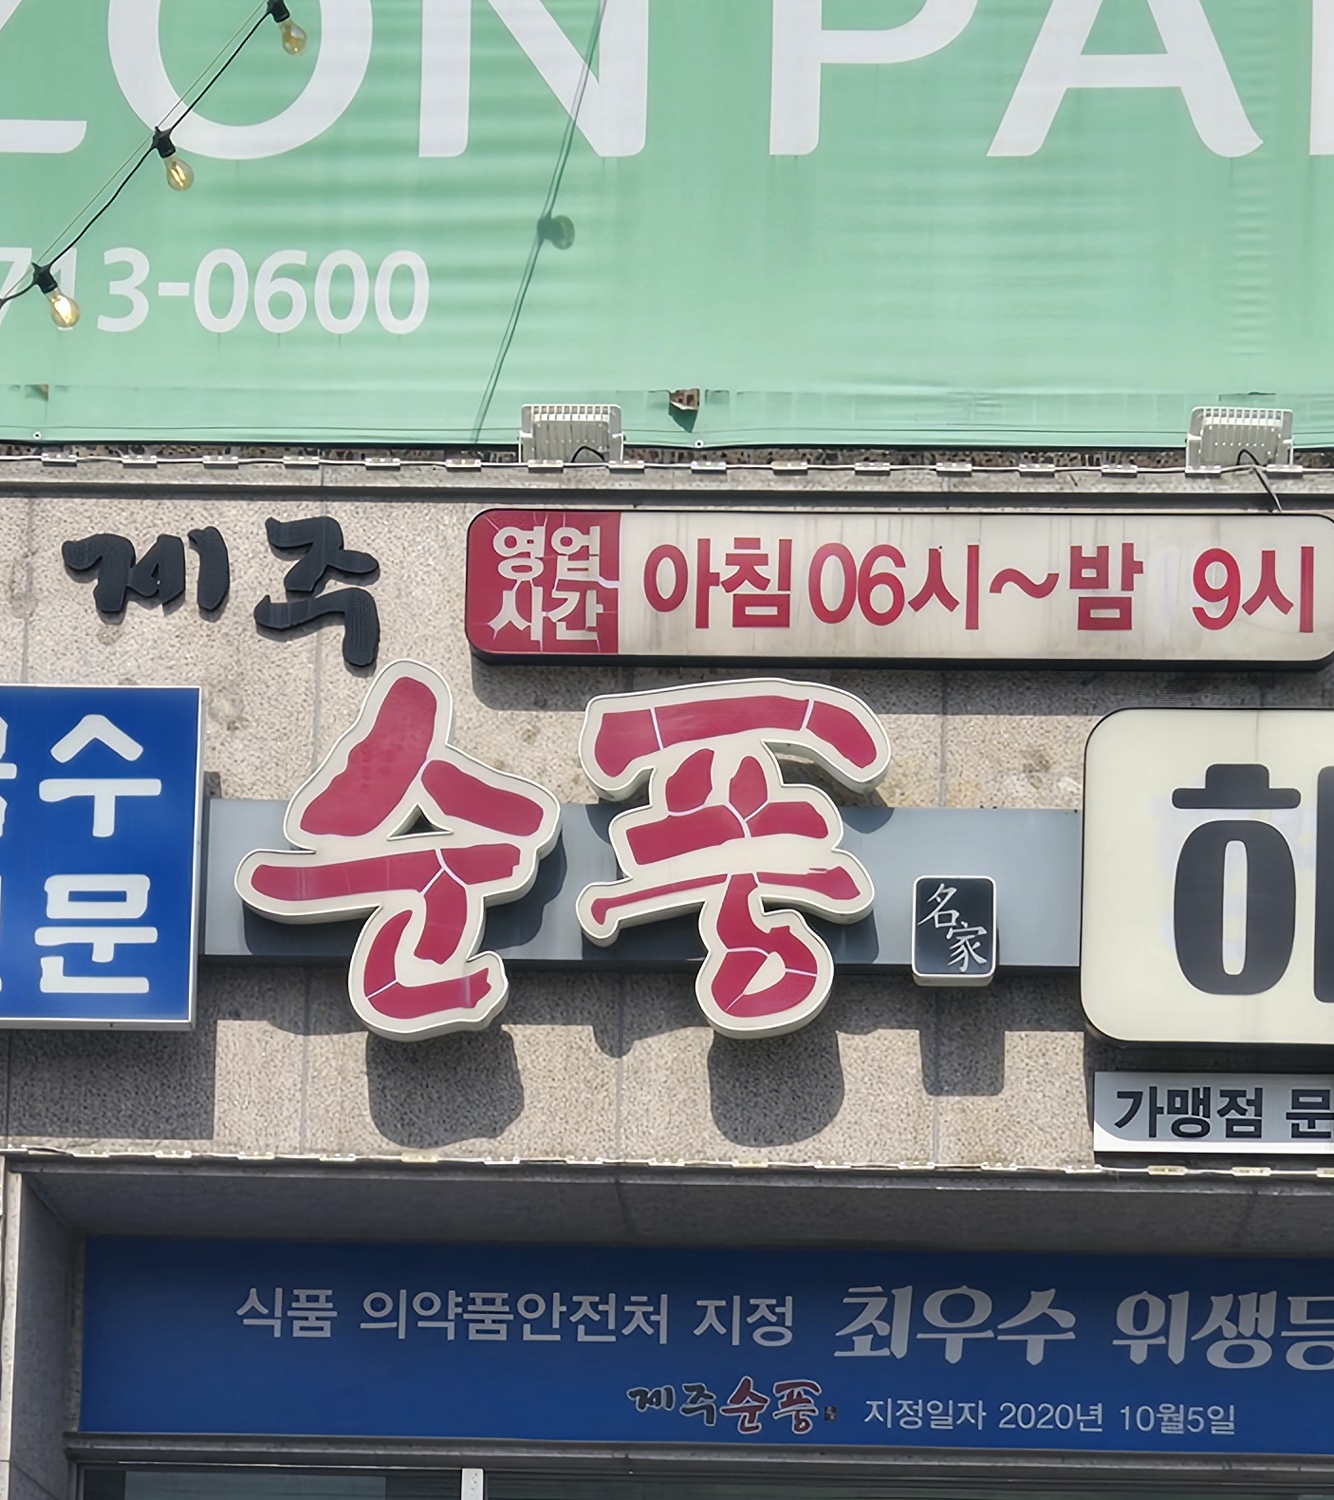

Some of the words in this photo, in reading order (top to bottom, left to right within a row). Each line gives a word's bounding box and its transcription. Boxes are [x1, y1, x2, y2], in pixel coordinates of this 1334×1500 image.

[62, 515, 381, 668] 제주
[492, 524, 603, 583] 영업
[1191, 544, 1316, 635] 9시
[489, 587, 605, 644] 시간
[245, 670, 883, 1024] 순풍
[915, 884, 989, 973] 名家
[1113, 1085, 1266, 1143] 가맹점
[235, 1286, 339, 1340] 식품
[358, 1287, 670, 1346] 의약품안전처
[691, 1293, 795, 1348] 지정
[832, 1284, 1078, 1366] 최우수
[861, 1397, 989, 1433] 지정일자
[998, 1400, 1104, 1434] 2020년
[1117, 1402, 1237, 1437] 10월5일
